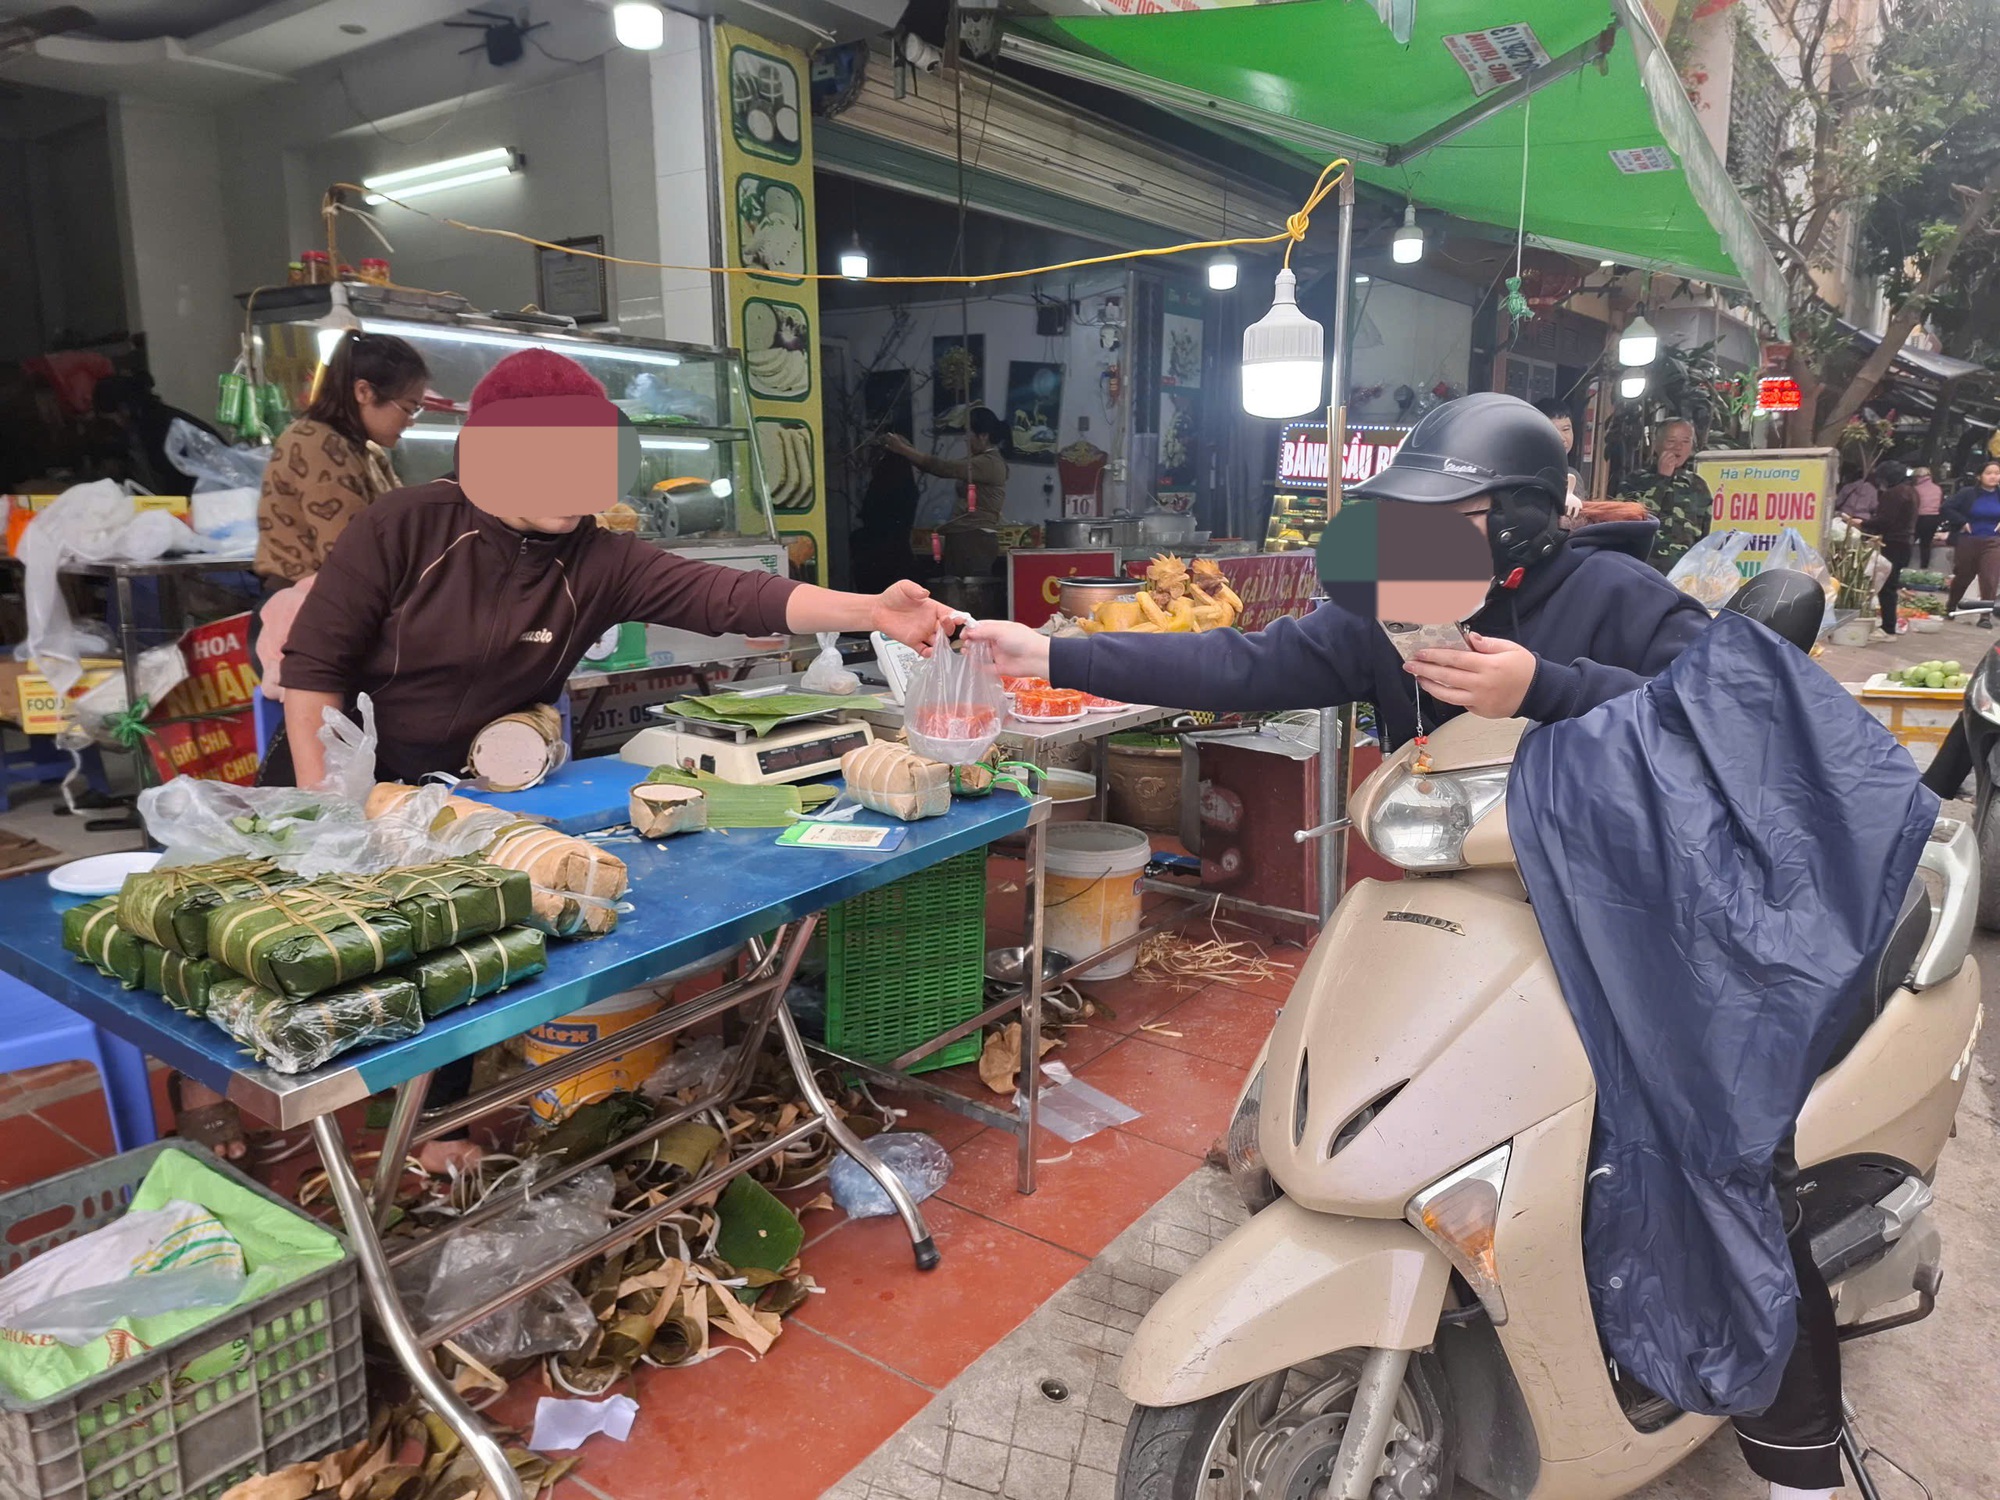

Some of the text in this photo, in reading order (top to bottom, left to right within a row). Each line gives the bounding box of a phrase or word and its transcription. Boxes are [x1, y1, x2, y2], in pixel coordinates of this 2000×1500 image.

[1730, 492, 1759, 521] GIA
[1765, 492, 1816, 527] DỤNG
[193, 633, 240, 660] HOA
